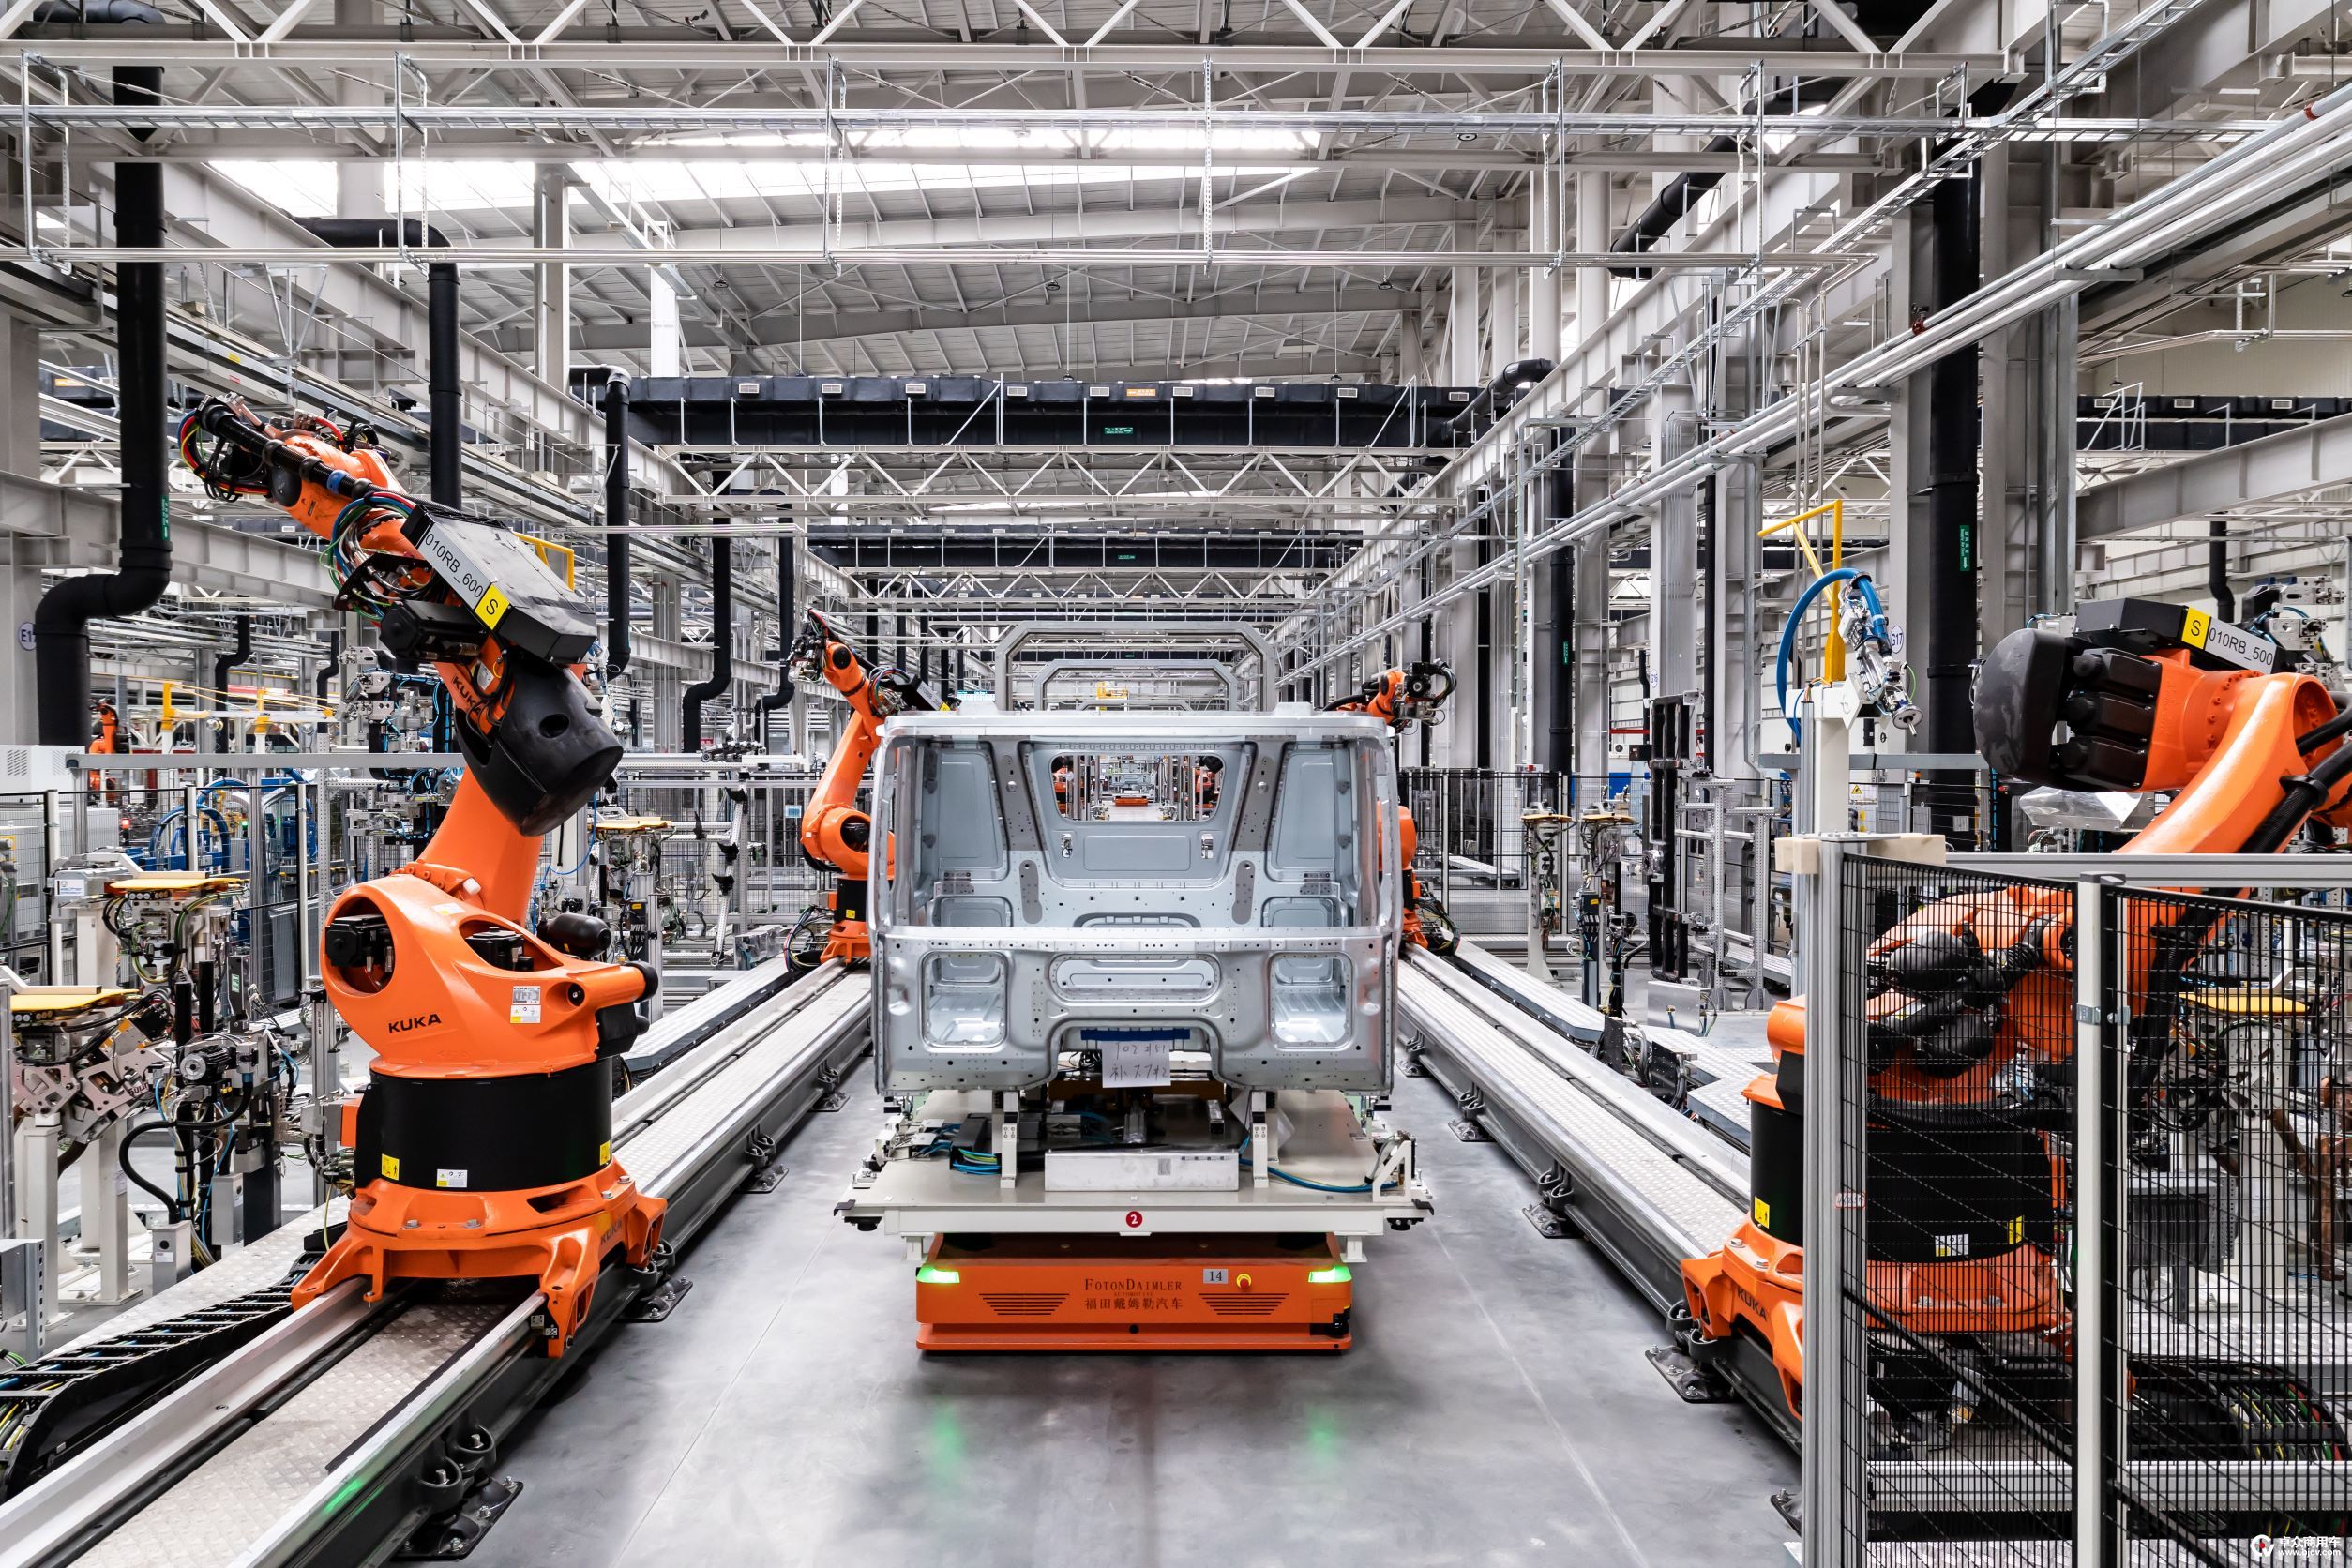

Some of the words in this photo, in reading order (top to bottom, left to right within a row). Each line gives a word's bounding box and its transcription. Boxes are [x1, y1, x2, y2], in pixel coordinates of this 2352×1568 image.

[425, 533, 484, 598] 010RB_600
[486, 598, 499, 615] S
[2190, 620, 2202, 636] S
[1892, 633, 1903, 646] G17
[2209, 627, 2273, 666] 010RB_500
[388, 1013, 443, 1033] KUKA
[1130, 1214, 1138, 1225] 2
[1209, 1271, 1223, 1282] 14
[1084, 1297, 1184, 1310] 福田戴姆勒汽车
[1737, 1285, 1767, 1321] KUKA
